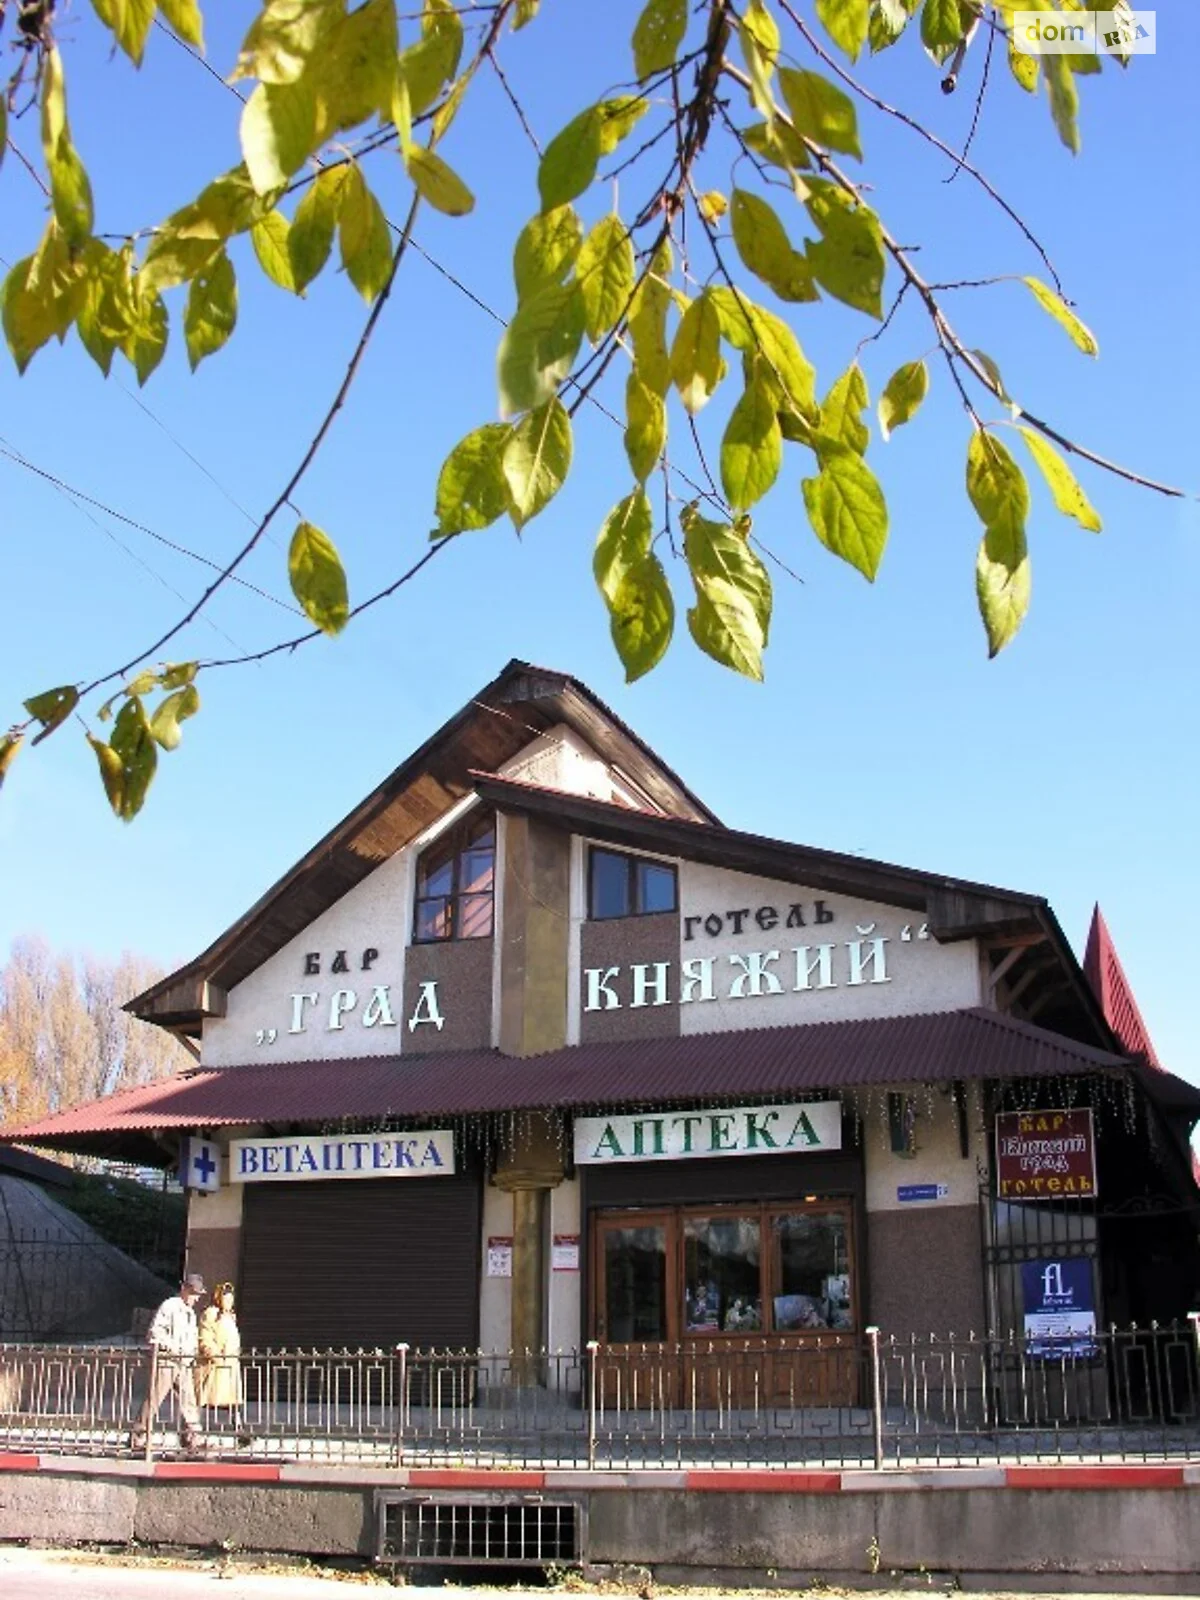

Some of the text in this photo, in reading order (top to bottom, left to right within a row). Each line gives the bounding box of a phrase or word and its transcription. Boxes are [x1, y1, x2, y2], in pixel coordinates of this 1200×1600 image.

[684, 900, 834, 941] ГОТЕЛЬ
[304, 948, 379, 975] БАР
[591, 1109, 822, 1158] АПТЕКА
[1019, 1115, 1064, 1132] БАР
[238, 1138, 445, 1175] ВЕТАПТЕКА
